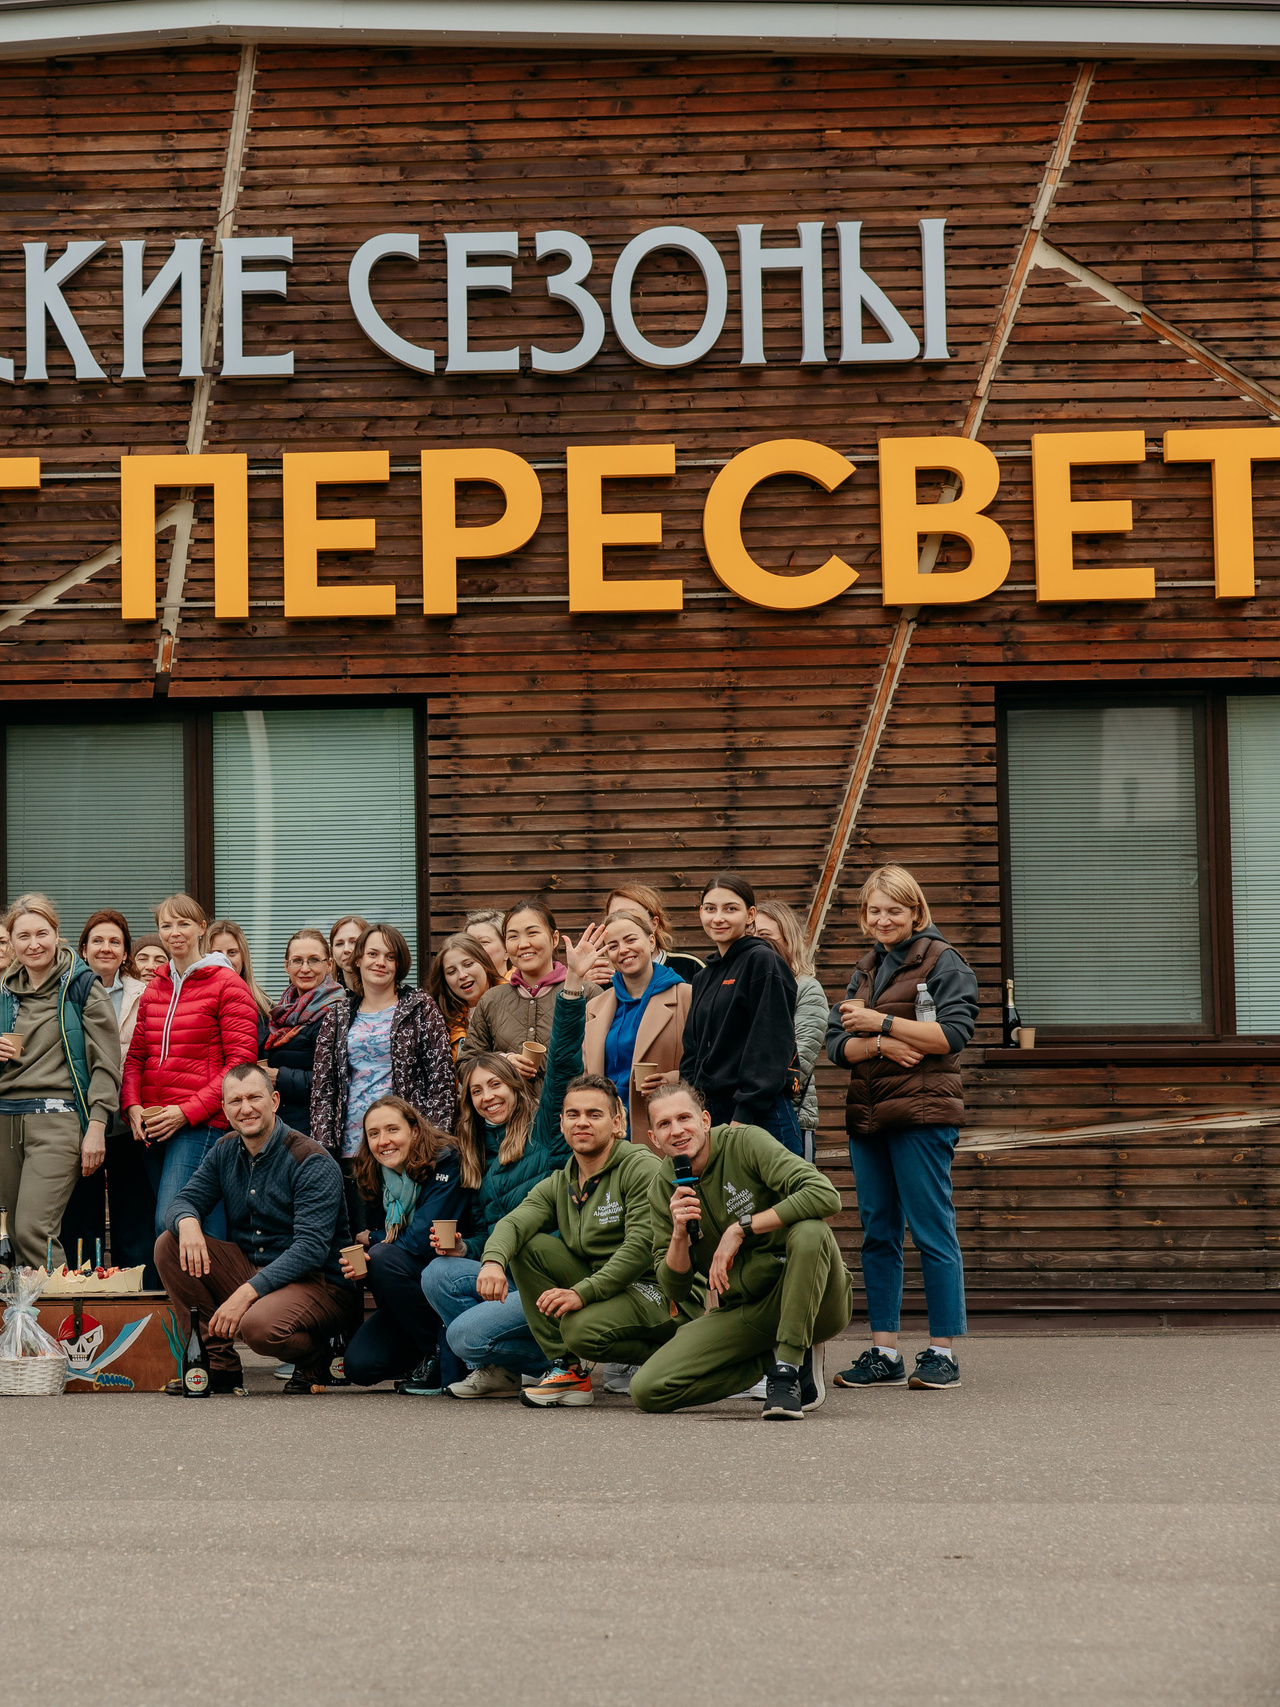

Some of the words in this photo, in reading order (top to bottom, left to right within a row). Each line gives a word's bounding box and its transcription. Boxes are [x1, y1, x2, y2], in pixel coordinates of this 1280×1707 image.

[348, 218, 951, 376] СЕЗОНЫ
[121, 427, 1280, 621] ПЕРЕСВЕТ
[435, 1173, 449, 1182] HH
[597, 1201, 619, 1211] КОМАНДА
[725, 1188, 749, 1208] КОМАНДА
